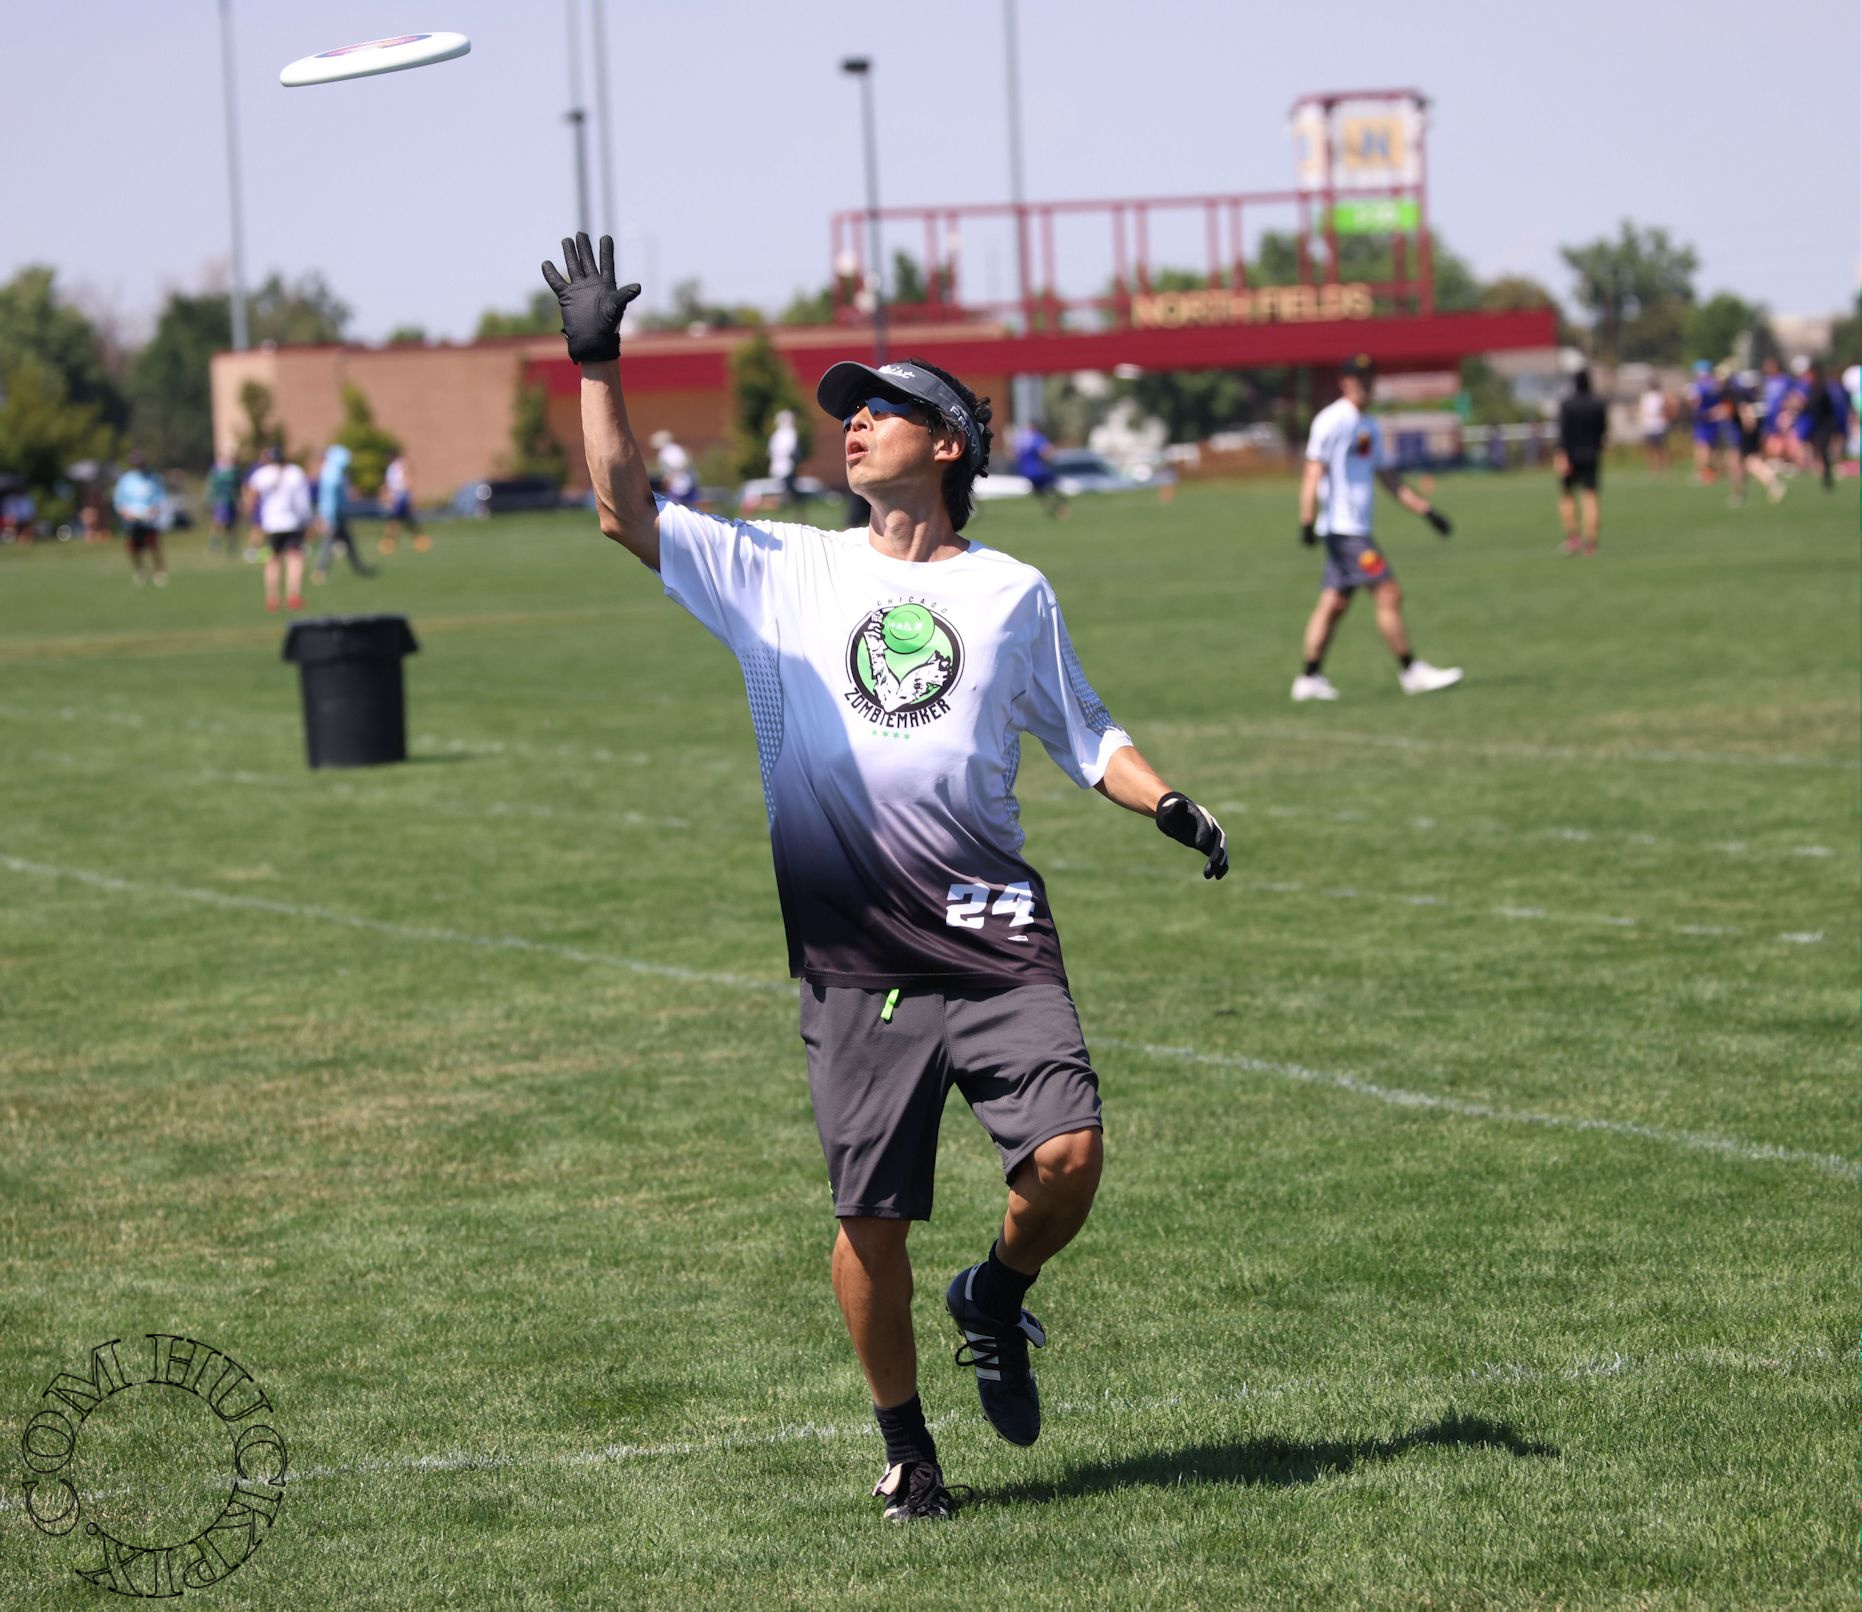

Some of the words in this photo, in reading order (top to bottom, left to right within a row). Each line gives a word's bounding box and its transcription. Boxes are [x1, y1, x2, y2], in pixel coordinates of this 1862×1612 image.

[876, 596, 949, 614] CHICAGO
[844, 687, 952, 729] ZOMBIEMAKER
[945, 881, 1036, 938] 24
